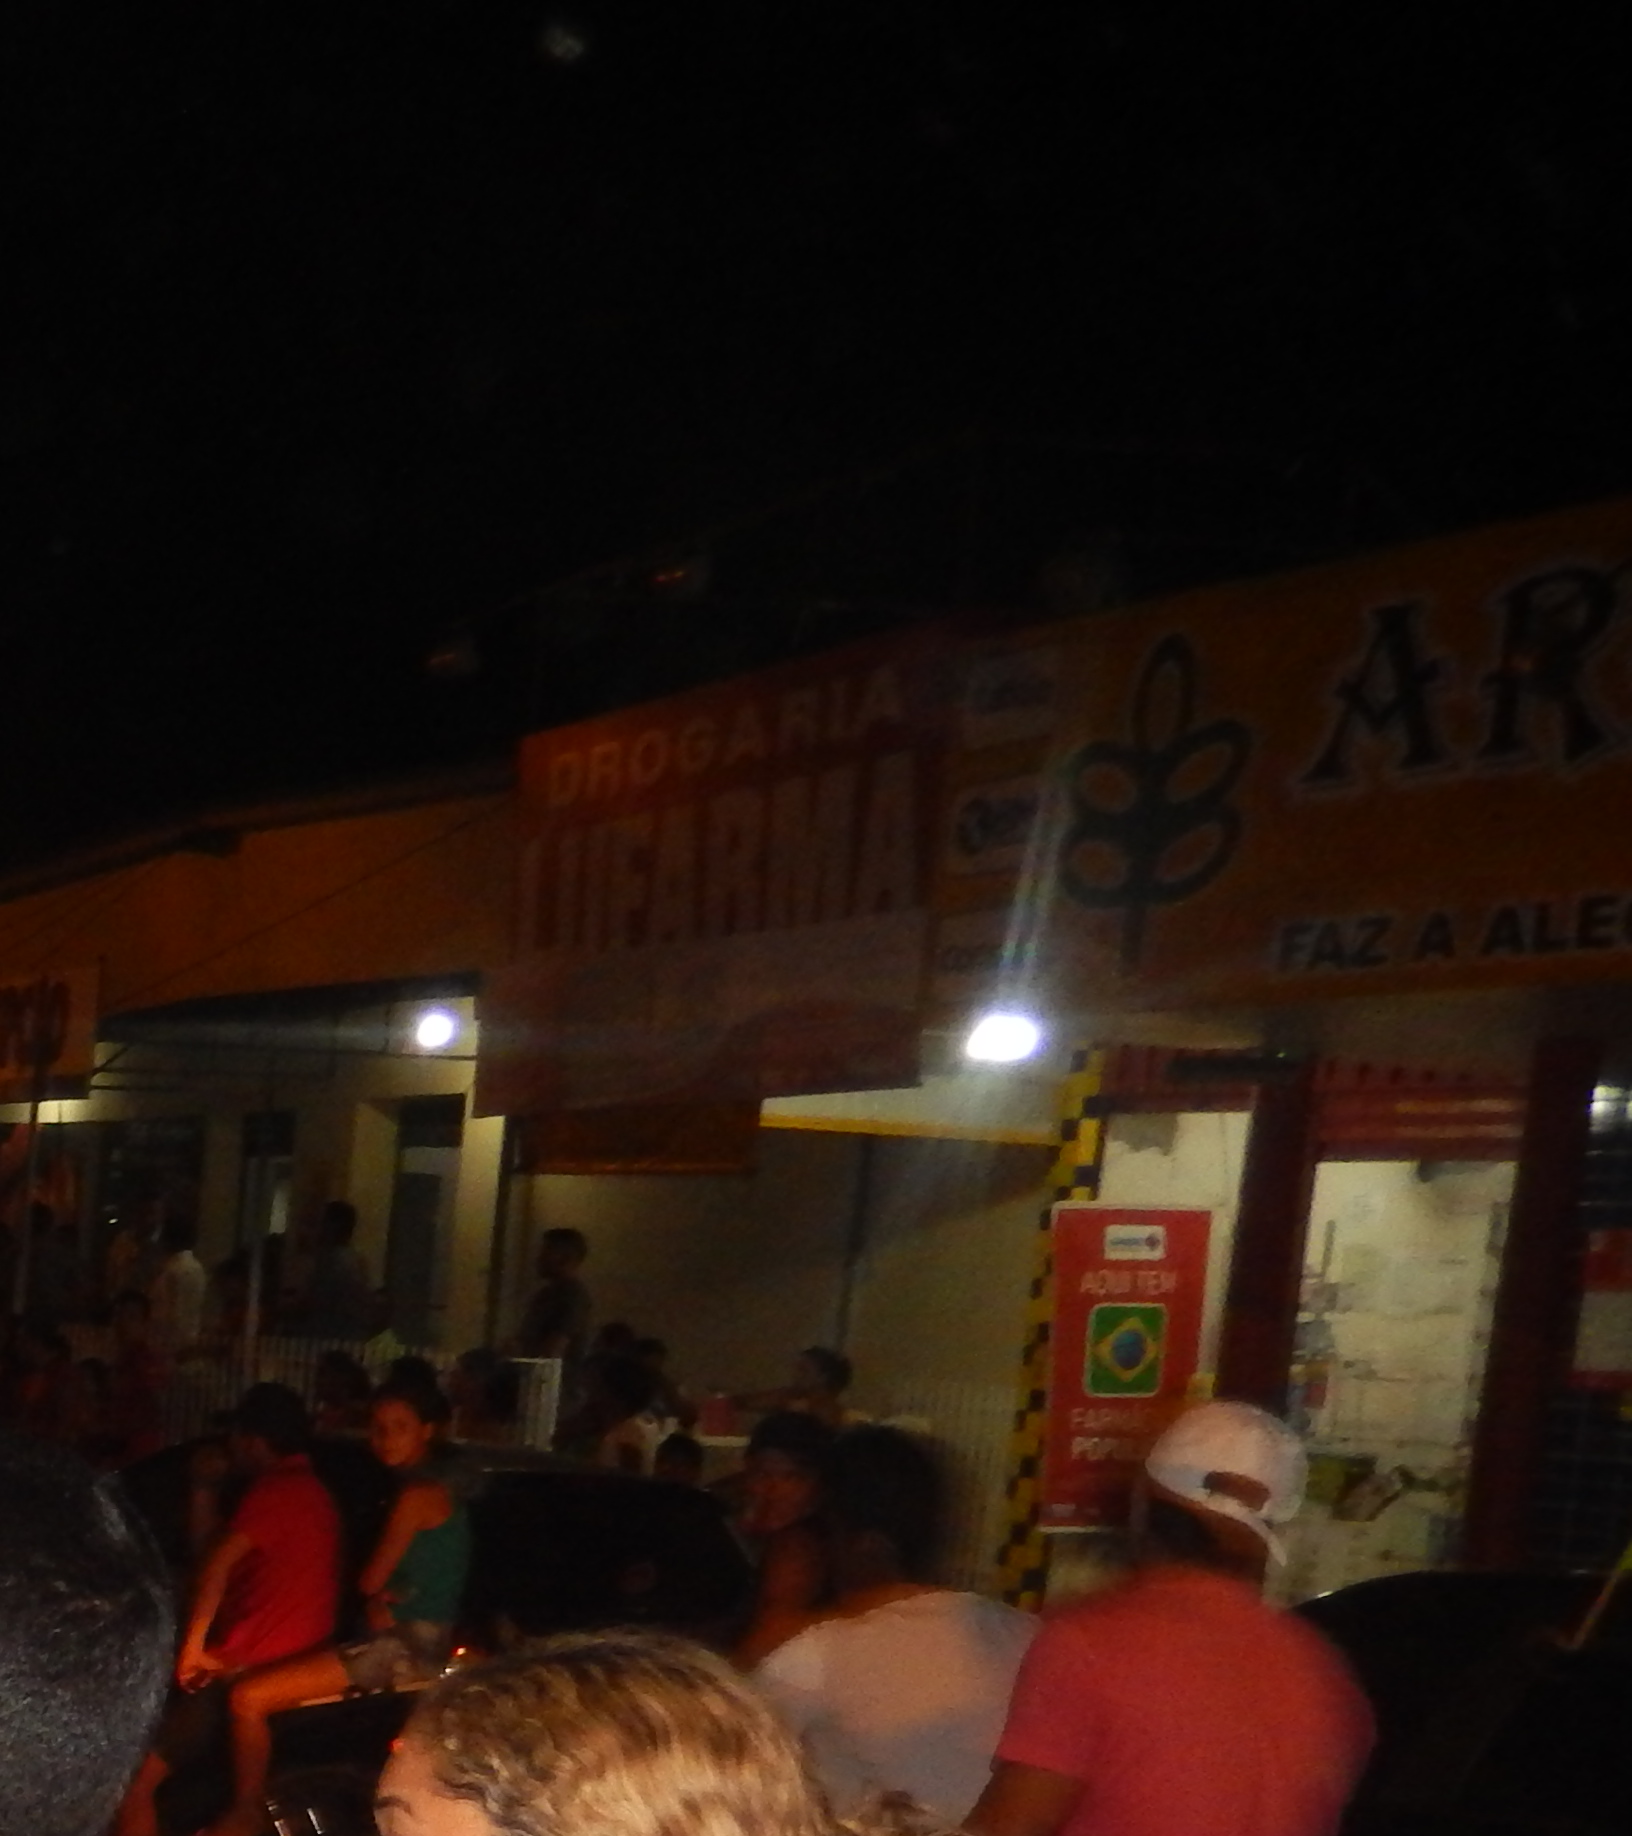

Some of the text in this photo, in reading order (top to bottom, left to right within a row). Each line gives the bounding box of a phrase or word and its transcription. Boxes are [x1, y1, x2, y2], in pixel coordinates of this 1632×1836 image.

[547, 660, 902, 807] DROGARIA
[1277, 895, 1632, 973] FAZ A ALE
